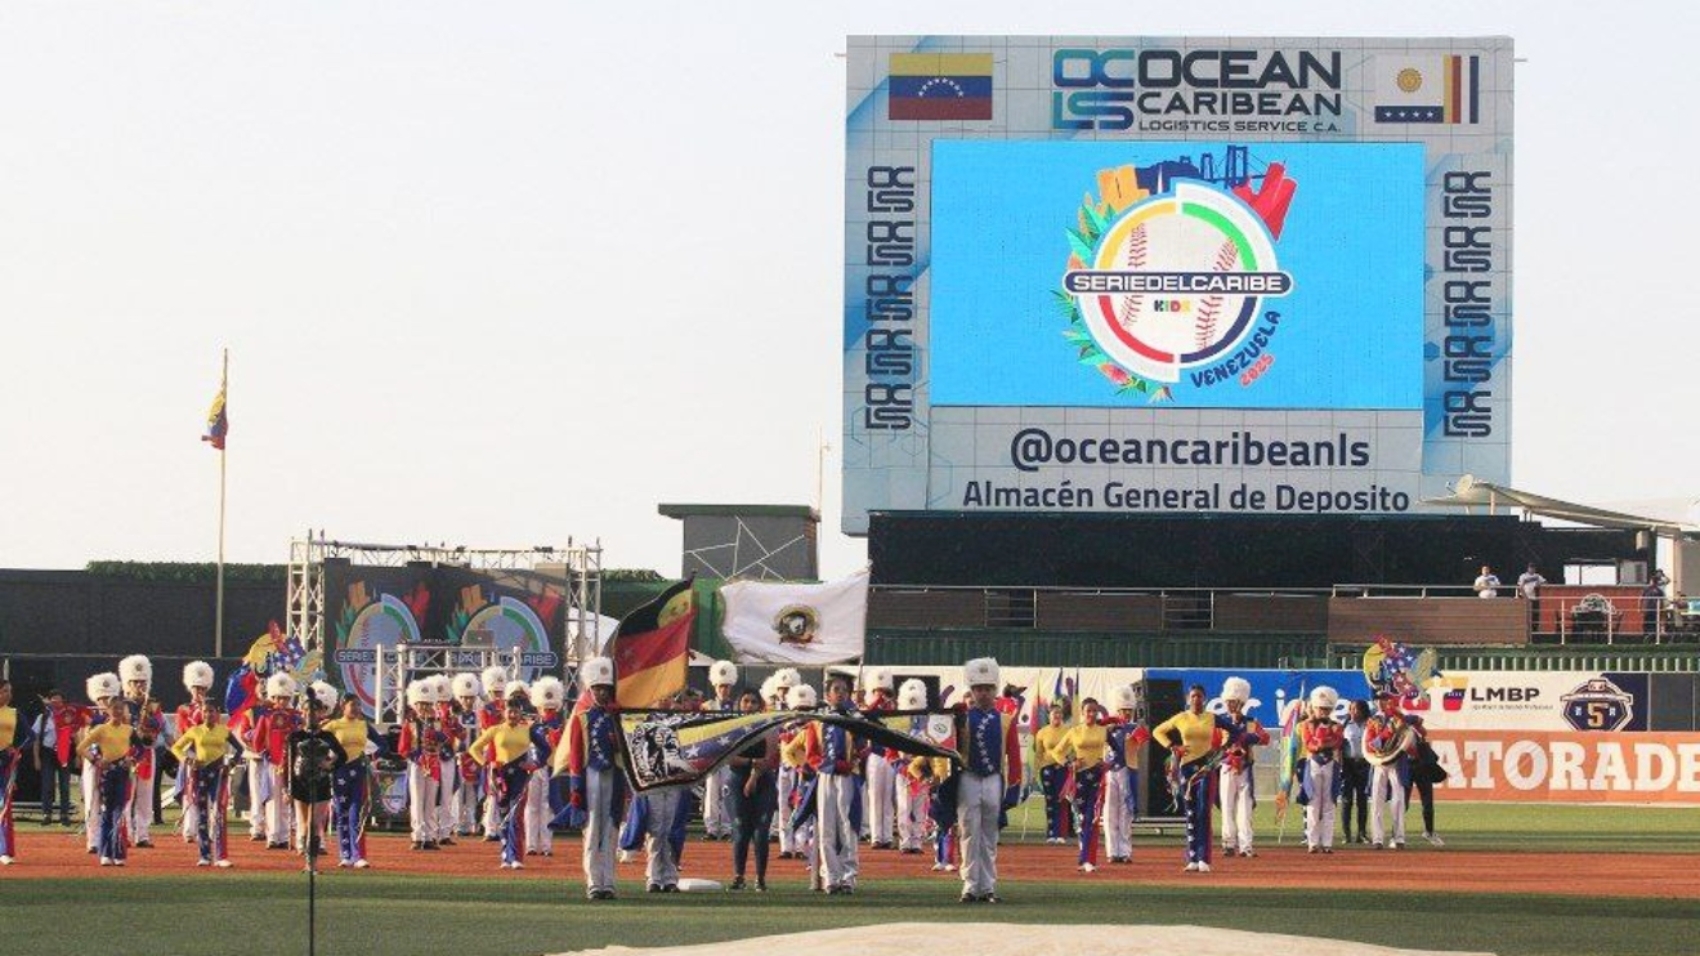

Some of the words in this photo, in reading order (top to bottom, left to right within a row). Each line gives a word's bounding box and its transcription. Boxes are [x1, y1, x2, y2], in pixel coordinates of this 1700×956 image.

[1138, 50, 1341, 89] OCEAN
[1137, 91, 1341, 116] CARIBEAN
[1138, 119, 1230, 132] LOGISTICS
[1234, 120, 1307, 133] SERVICE
[1312, 121, 1342, 133] C.A.
[1073, 275, 1283, 292] SERIEDELCARIBE
[1190, 310, 1282, 389] VENEZUELA
[1011, 428, 1369, 472] @oceancaribeanls
[963, 479, 1093, 508] Almacén
[1104, 481, 1219, 509] General
[1229, 483, 1266, 510] de
[1276, 484, 1409, 514] Deposito
[1471, 687, 1540, 702] LMBP
[1431, 740, 1700, 792] ATORADE
